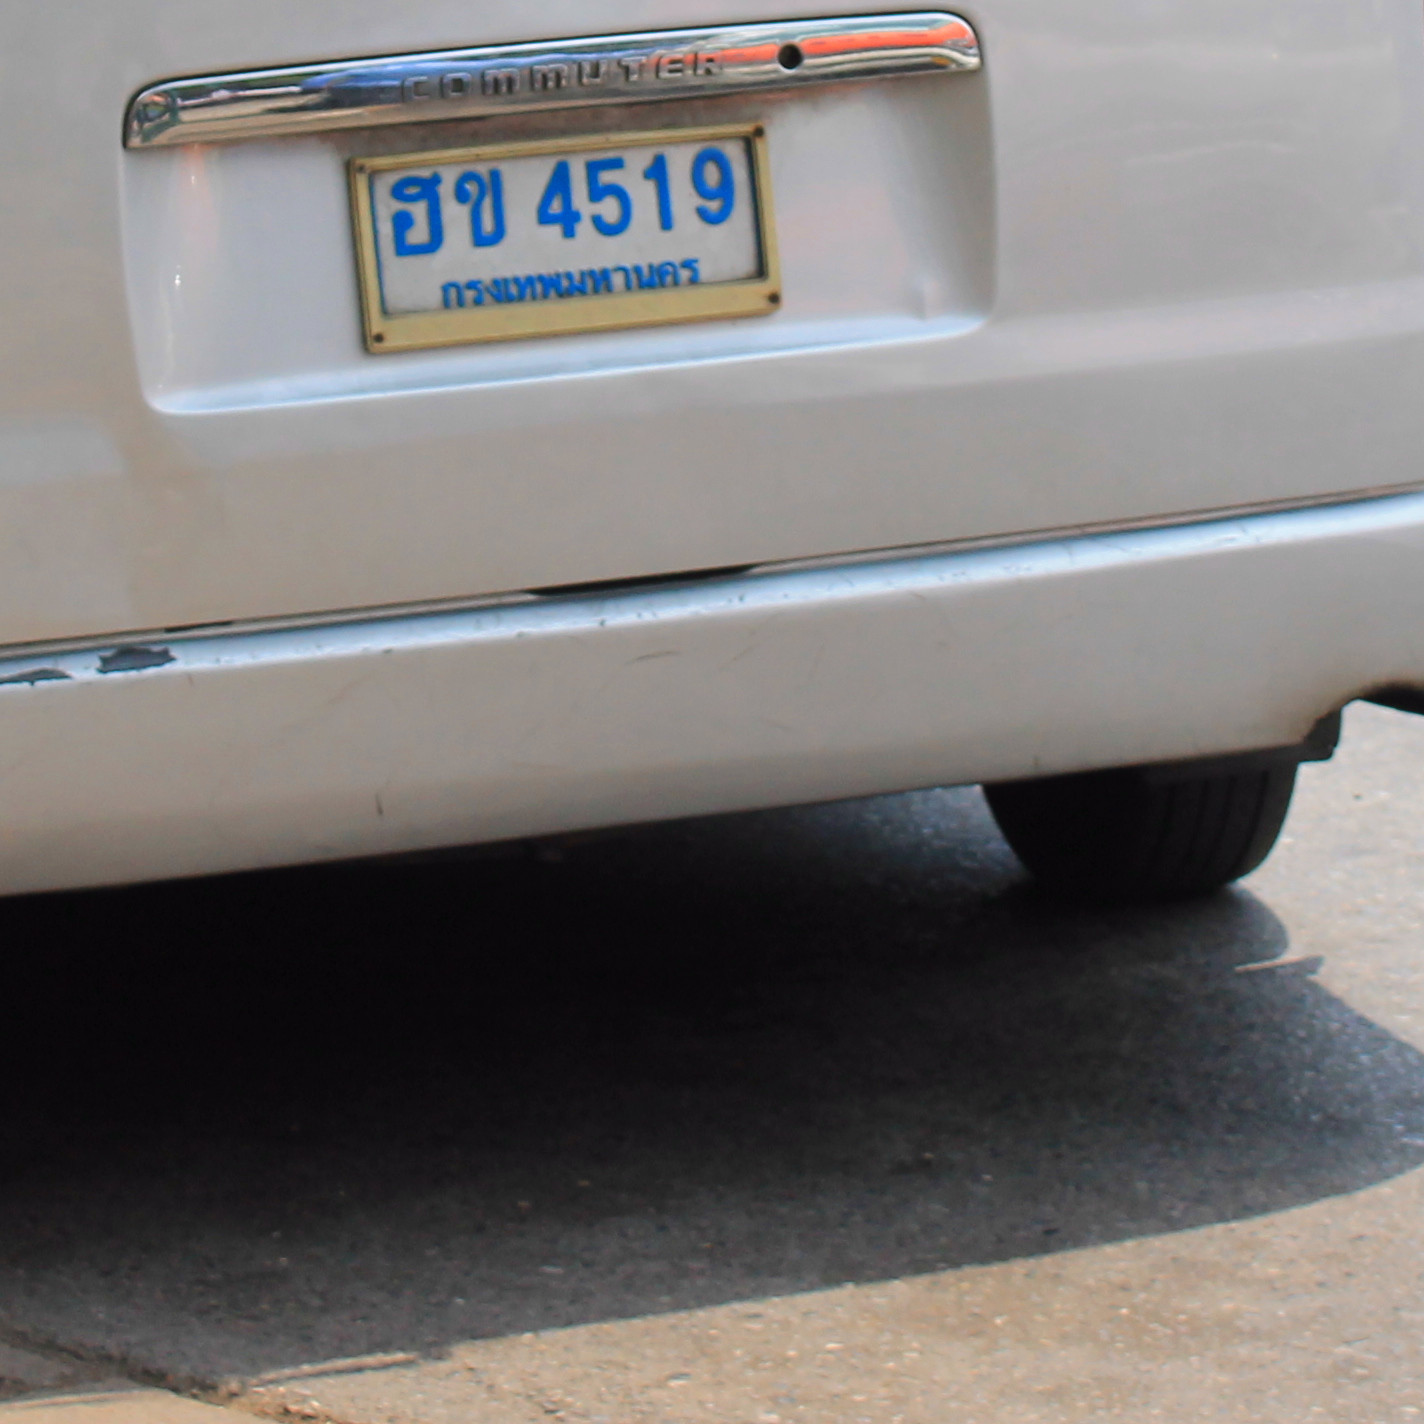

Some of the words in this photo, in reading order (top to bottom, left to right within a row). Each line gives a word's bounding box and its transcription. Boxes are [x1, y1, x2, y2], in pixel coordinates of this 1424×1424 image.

[400, 51, 724, 102] COMMUTER
[390, 167, 506, 257] ฮข
[537, 146, 735, 239] 4519
[441, 257, 701, 309] กรงเทพมหานคร
